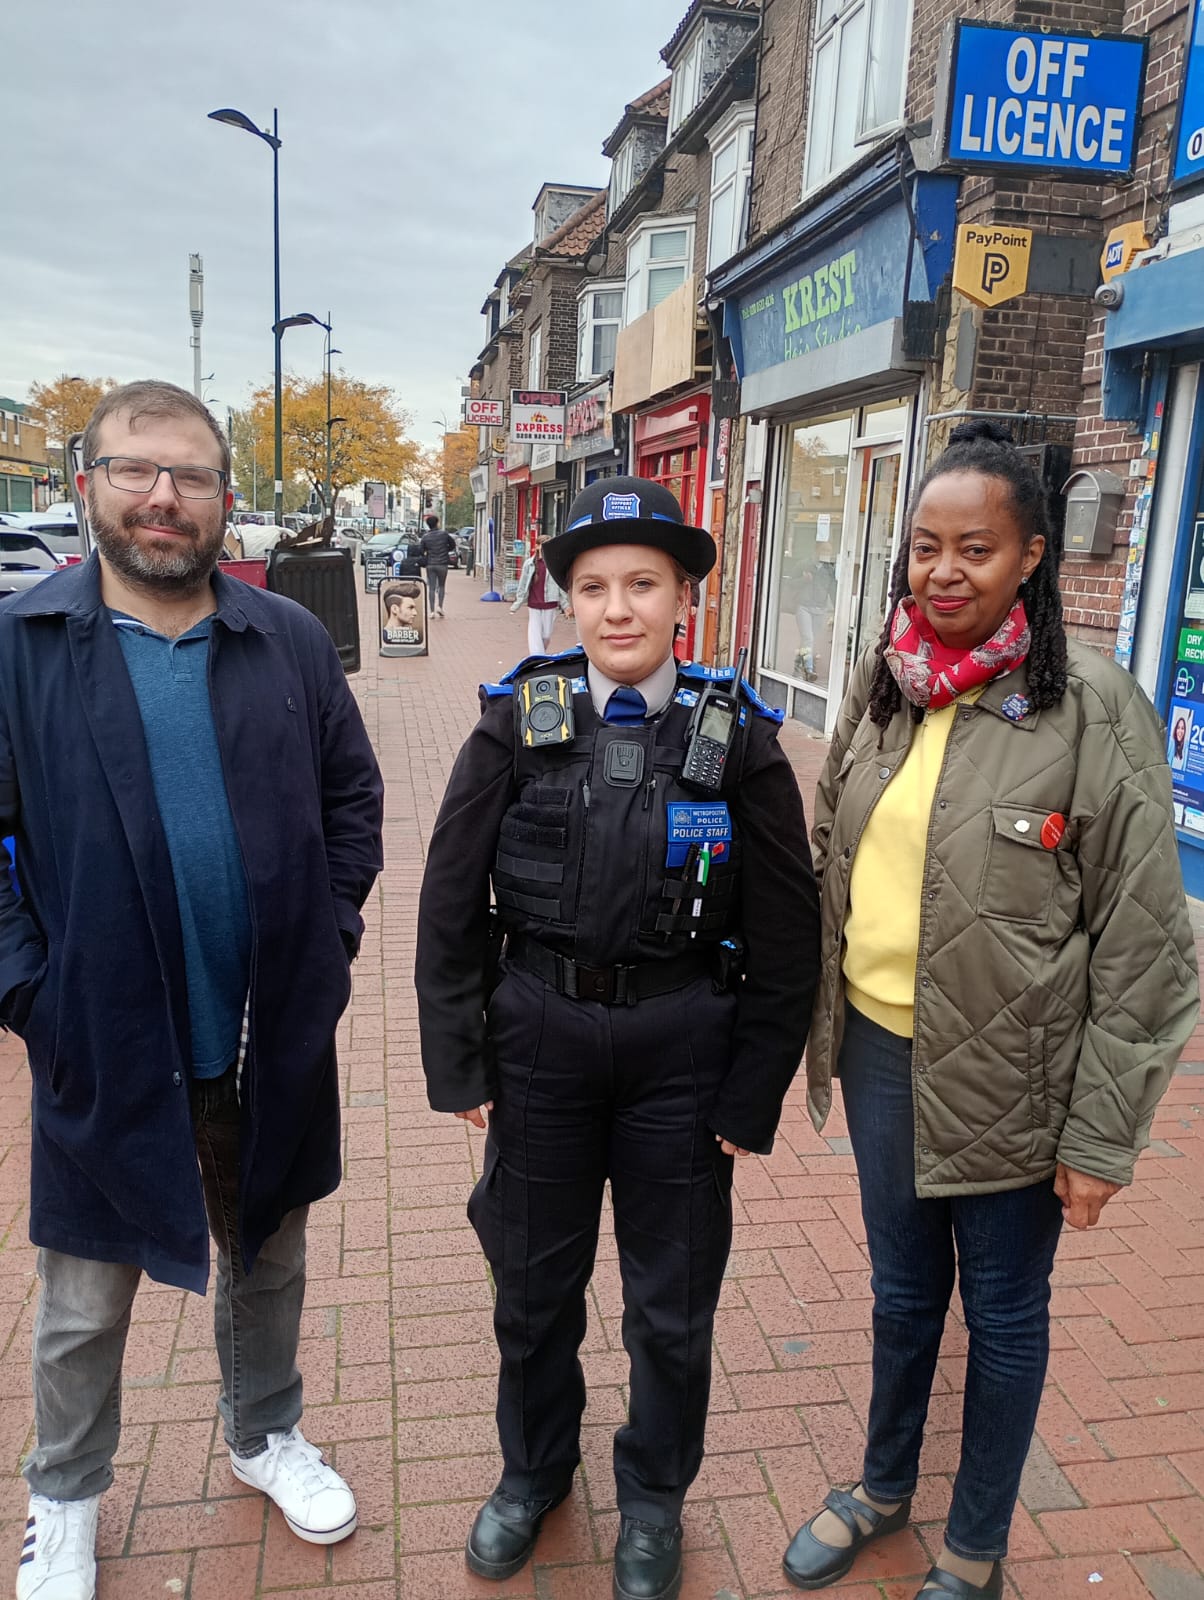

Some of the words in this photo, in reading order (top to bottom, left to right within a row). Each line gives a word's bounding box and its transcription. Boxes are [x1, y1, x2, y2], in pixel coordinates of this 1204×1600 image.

[1006, 37, 1089, 98] OFF
[960, 94, 1126, 163] LICENCE
[966, 231, 1028, 247] PayPoint
[1106, 244, 1123, 264] ADT
[783, 249, 857, 334] KREST
[519, 393, 561, 405] OPEN
[471, 402, 499, 413] OFF
[467, 414, 502, 424] LICENCE
[516, 423, 563, 432] EXPRESS
[387, 630, 419, 640] BARBER
[1187, 634, 1203, 645] DRY
[673, 829, 704, 838] POLICE
[706, 828, 729, 837] STAFF
